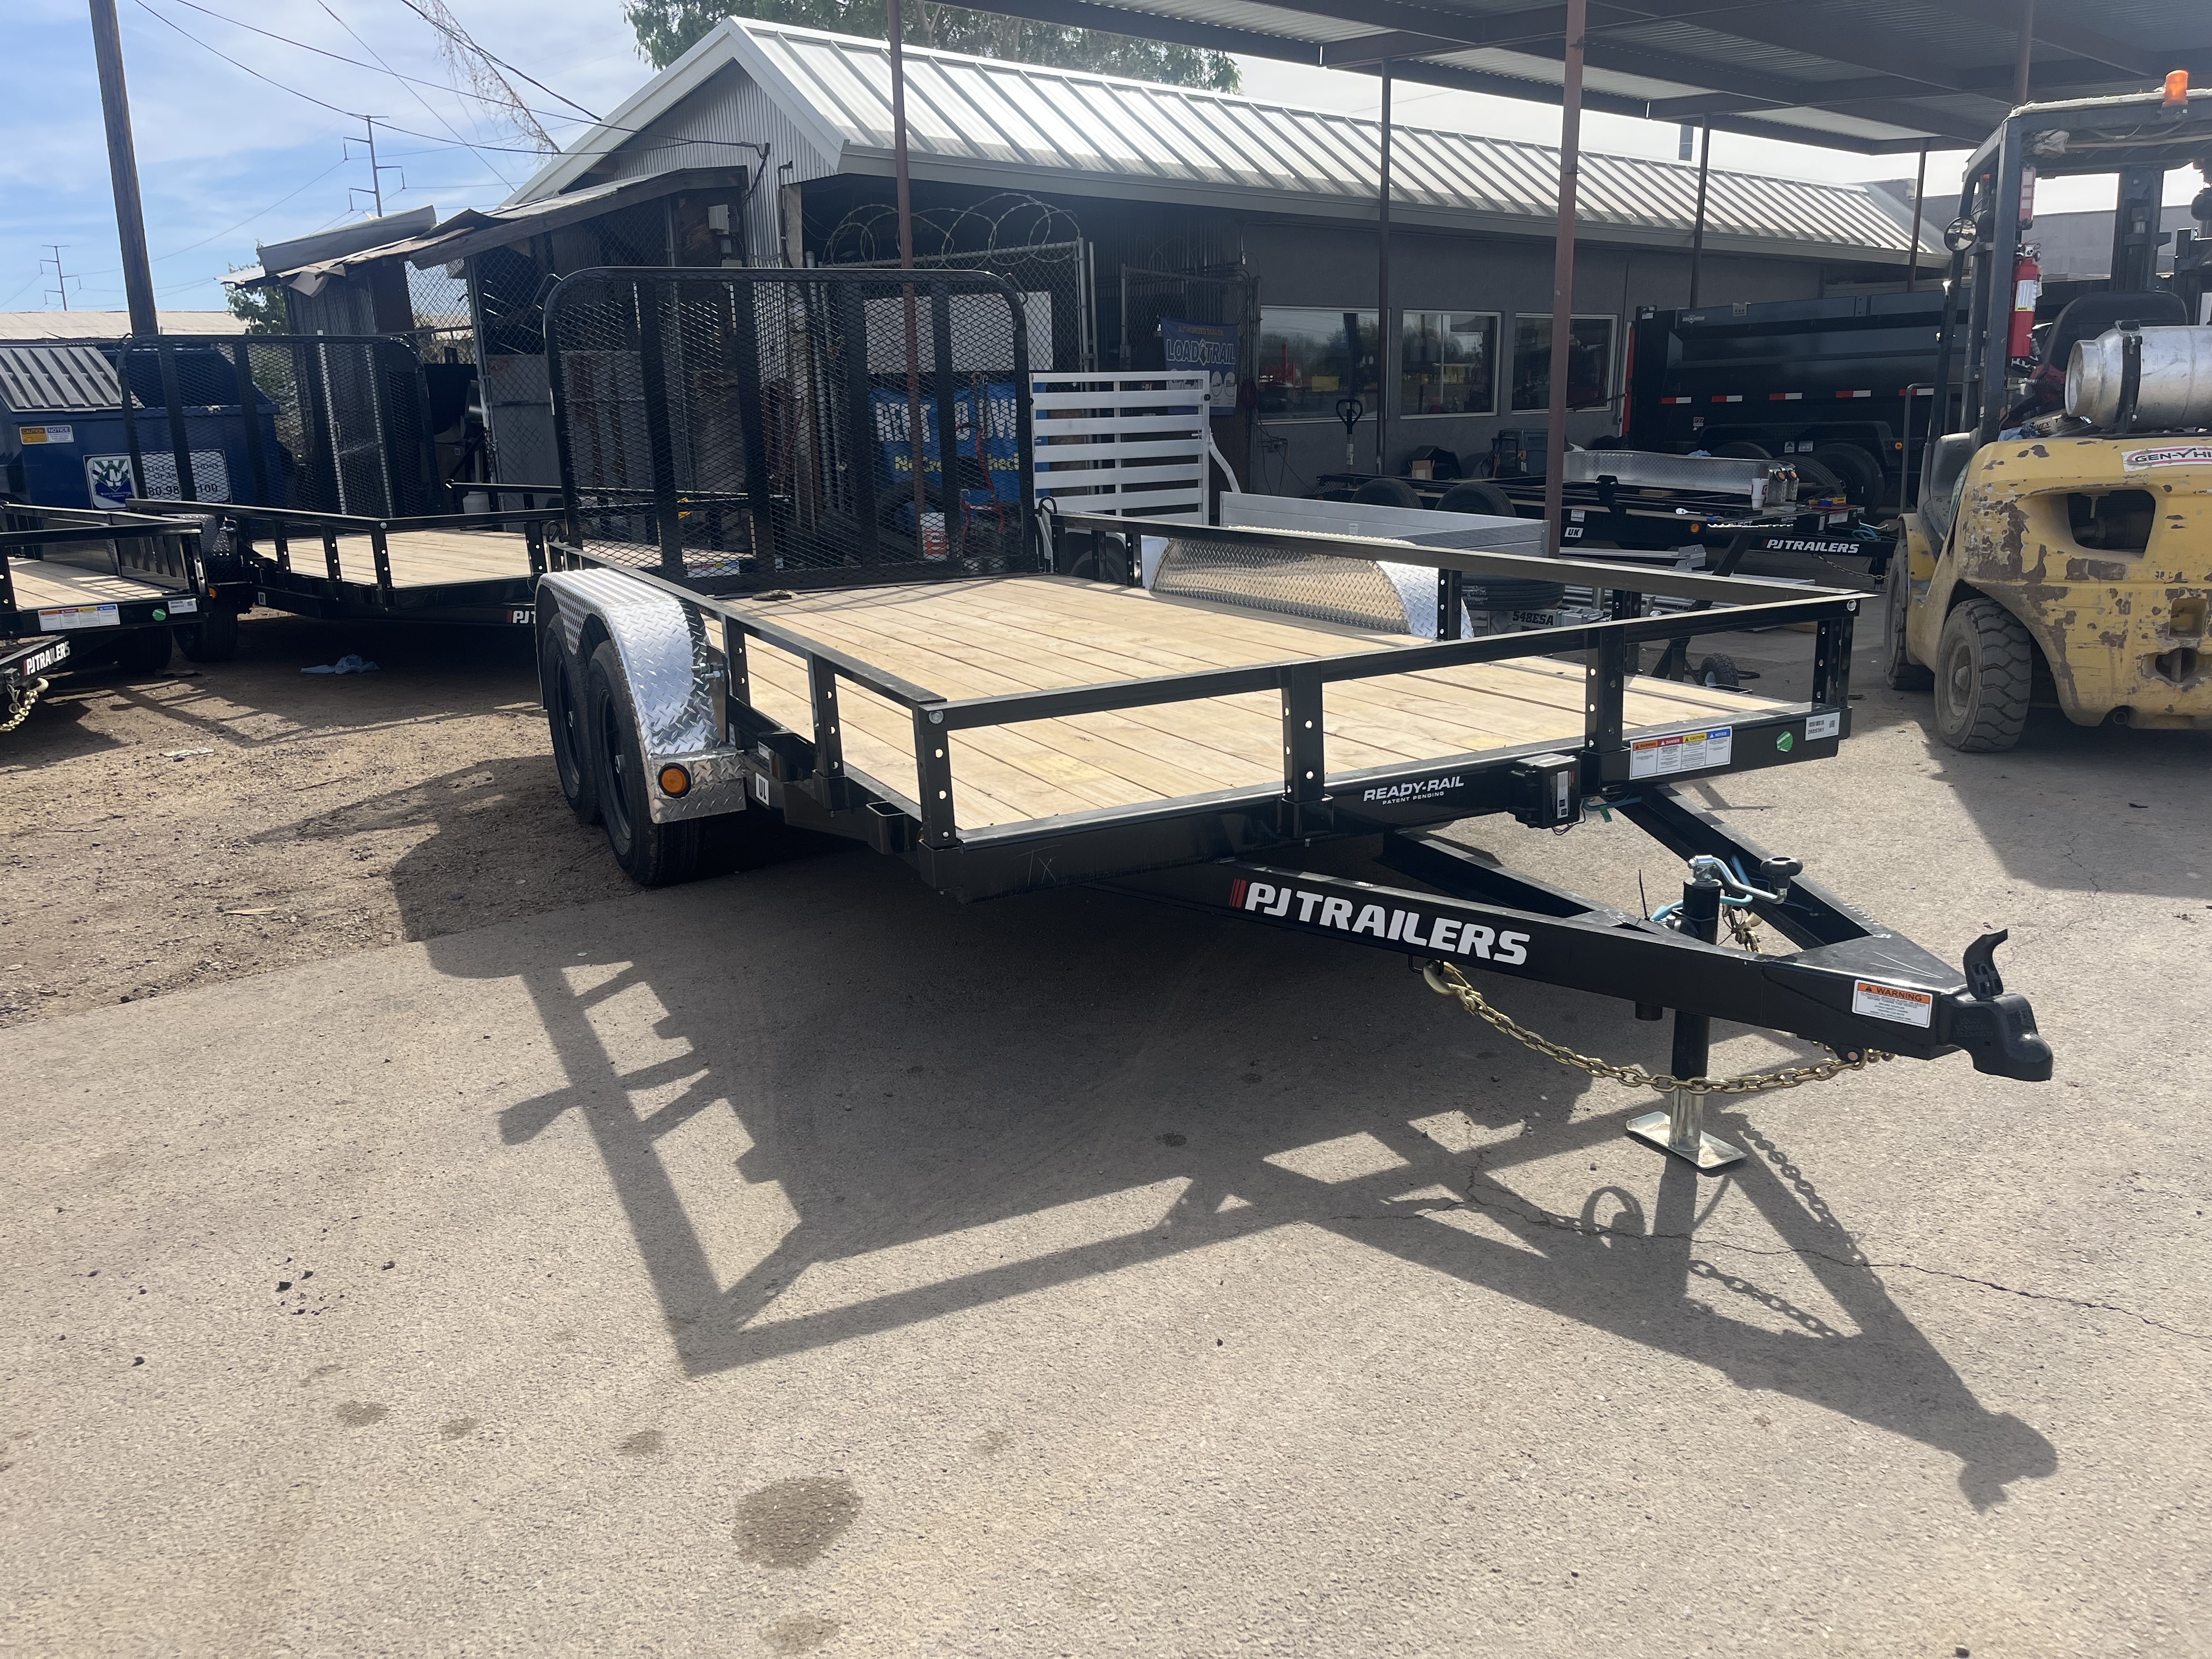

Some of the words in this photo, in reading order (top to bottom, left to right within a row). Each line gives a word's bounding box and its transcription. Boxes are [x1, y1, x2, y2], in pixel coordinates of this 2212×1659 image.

[1166, 338, 1200, 363] LOAD
[1205, 341, 1236, 365] TRAIL
[2135, 448, 2196, 462] GEN-Y
[1767, 539, 1784, 549] PJ
[1784, 540, 1860, 554] TRAILERS
[512, 610, 529, 624] PJ
[1512, 611, 1554, 626] 548ESA
[26, 656, 36, 675] PJ
[35, 641, 70, 670] TRAILERS
[759, 778, 766, 800] UL
[1363, 776, 1464, 802] READY-RAIL
[1383, 797, 1409, 805] PATENT
[1413, 791, 1444, 800] PENDING
[1244, 882, 1292, 917] PJ
[1296, 890, 1531, 966] TRAILERS
[1876, 987, 1922, 1001] WARNING
